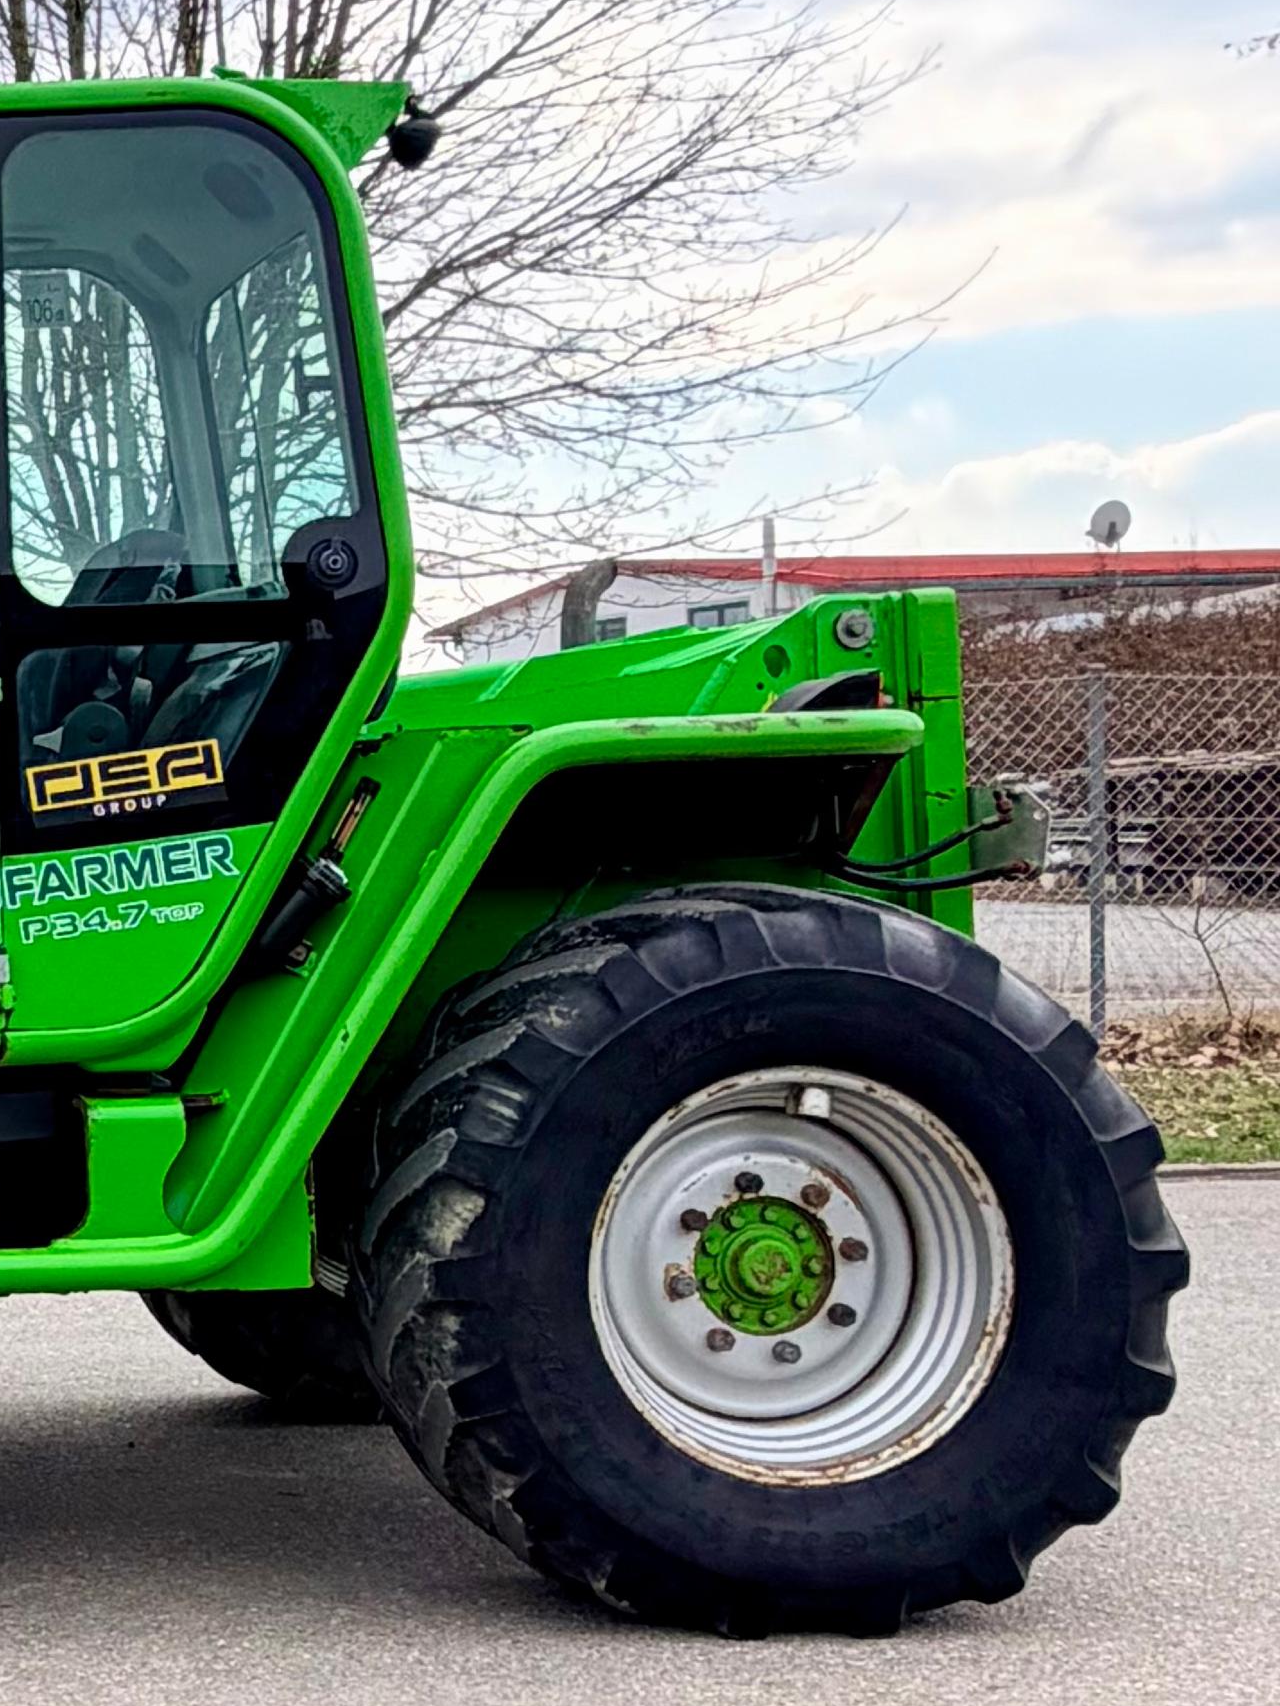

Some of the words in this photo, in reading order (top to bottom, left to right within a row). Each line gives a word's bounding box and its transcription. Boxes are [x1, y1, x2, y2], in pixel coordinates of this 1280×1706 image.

[93, 794, 167, 817] GROUP
[19, 900, 148, 944] P34.7
[150, 902, 205, 924] TOP
